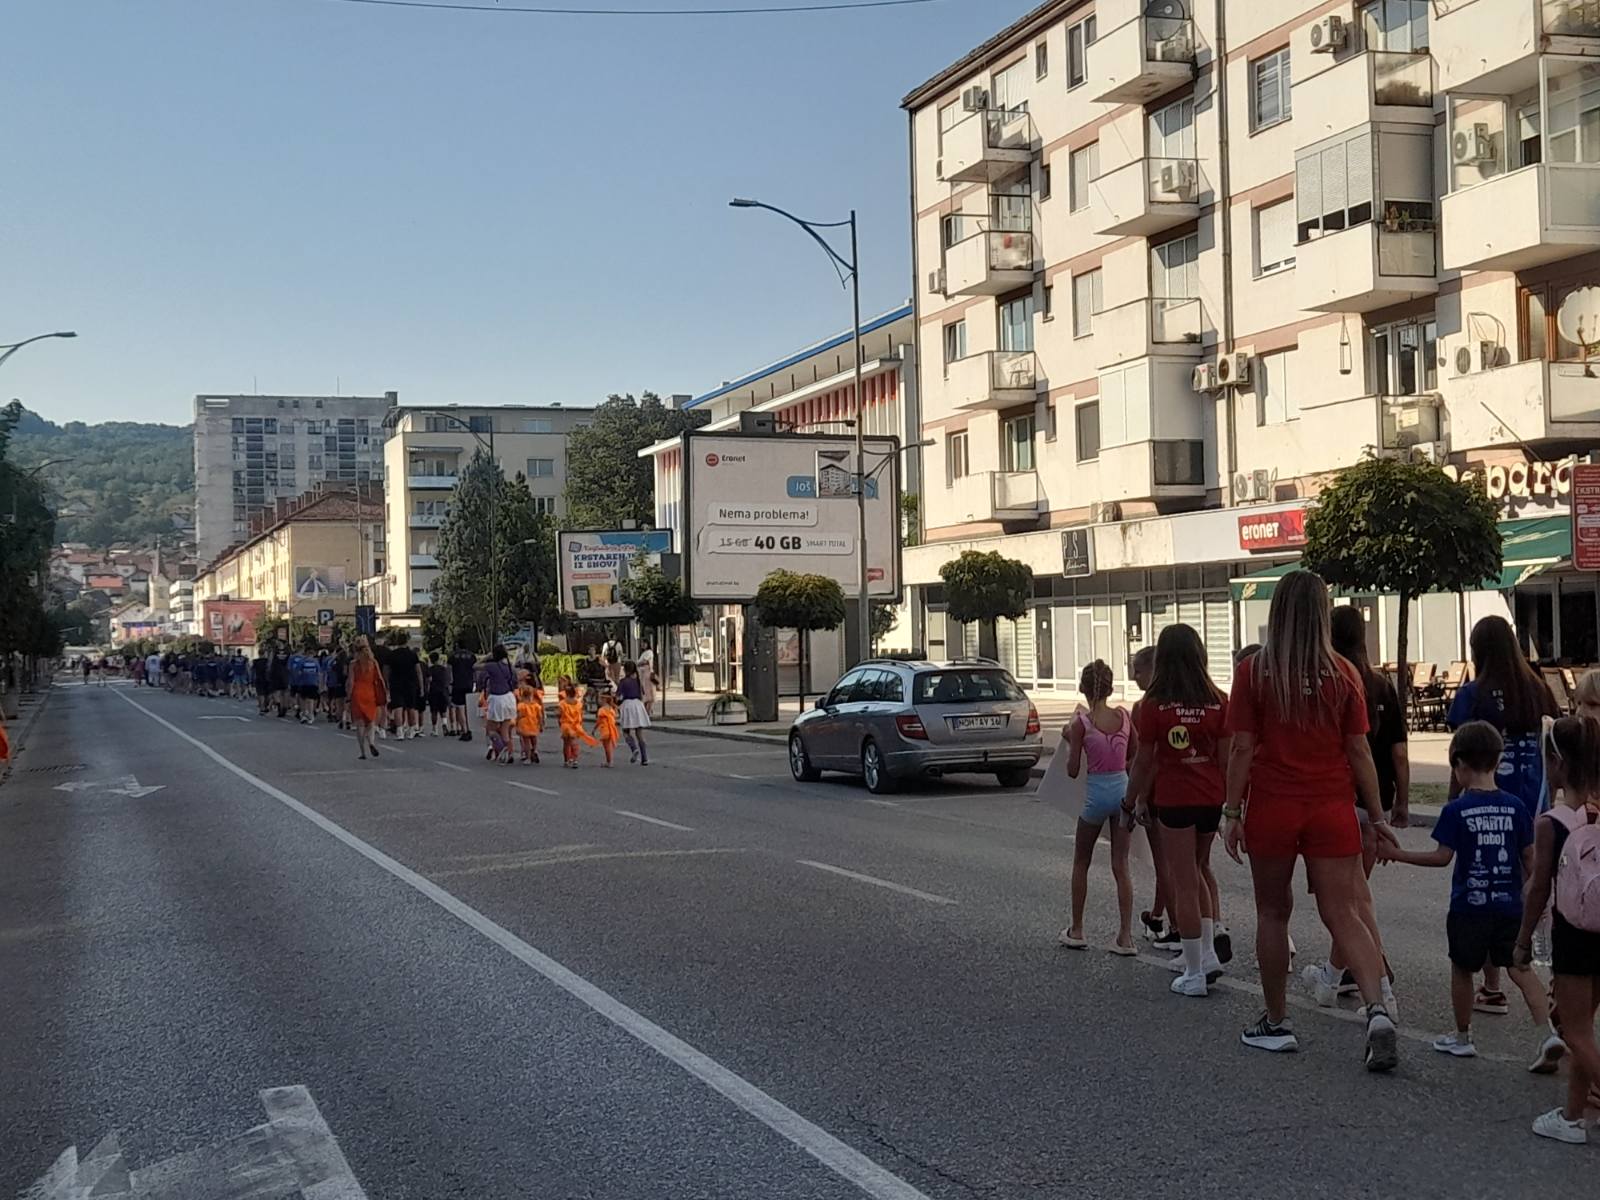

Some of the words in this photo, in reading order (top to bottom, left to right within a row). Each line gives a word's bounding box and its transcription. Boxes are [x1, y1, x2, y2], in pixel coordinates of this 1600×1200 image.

[719, 508, 751, 519] Nema
[753, 509, 809, 521] problema!
[754, 536, 775, 550] 40
[780, 536, 802, 550] GB
[320, 611, 330, 623] P
[1466, 816, 1514, 832] SPARTA
